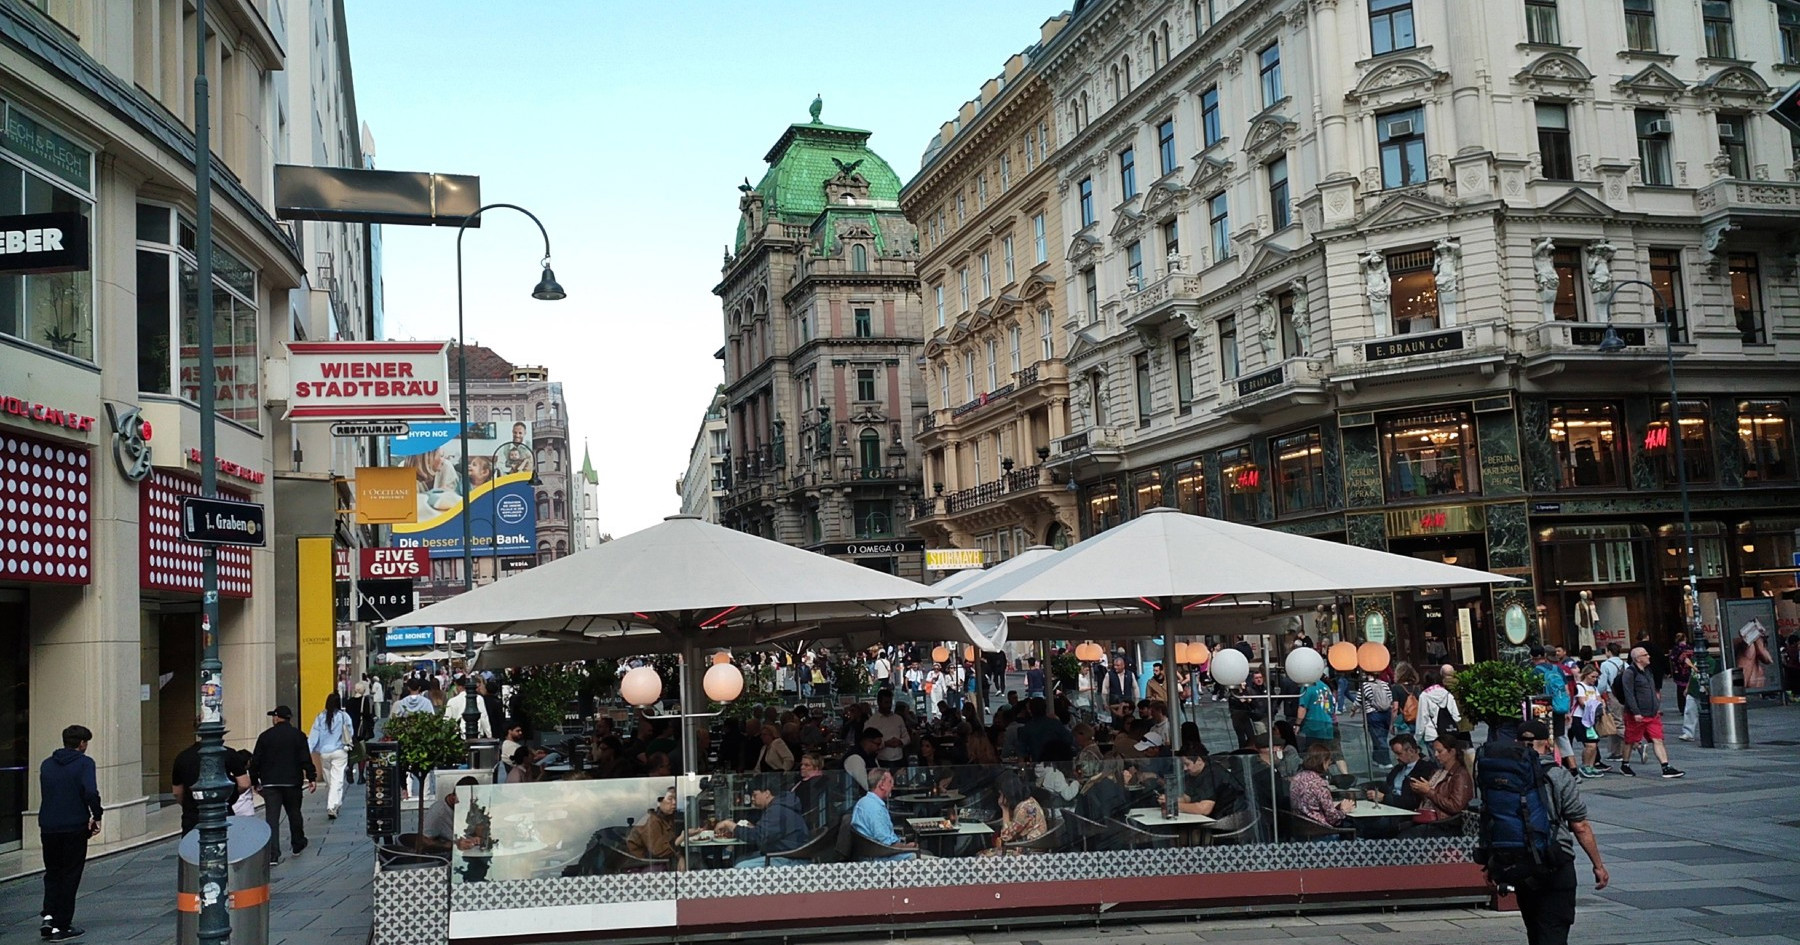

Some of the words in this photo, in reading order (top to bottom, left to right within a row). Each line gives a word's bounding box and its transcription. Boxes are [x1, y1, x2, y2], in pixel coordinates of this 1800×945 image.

[36, 134, 44, 150] &
[45, 139, 82, 170] PLECH
[1376, 346, 1386, 357] E.
[1389, 340, 1426, 355] BRAUN
[1430, 342, 1435, 350] &
[320, 362, 414, 379] WIENER
[295, 381, 439, 398] STADTBRÄU
[33, 403, 65, 427] CAN
[68, 412, 96, 432] EAT
[336, 425, 403, 435] RESTAURANT
[1644, 427, 1667, 450] H&M
[1238, 470, 1259, 487] H&M
[215, 513, 248, 532] Graben
[1420, 512, 1446, 529] H&M
[399, 538, 419, 548] Die
[422, 537, 459, 547] besser
[462, 536, 493, 546] lben
[496, 534, 529, 544] Bank.
[859, 544, 891, 554] OMEGA
[375, 549, 414, 562] FIVE
[370, 562, 420, 575] GUYS
[405, 631, 433, 640] MONEY
[1596, 630, 1626, 641] SALE
